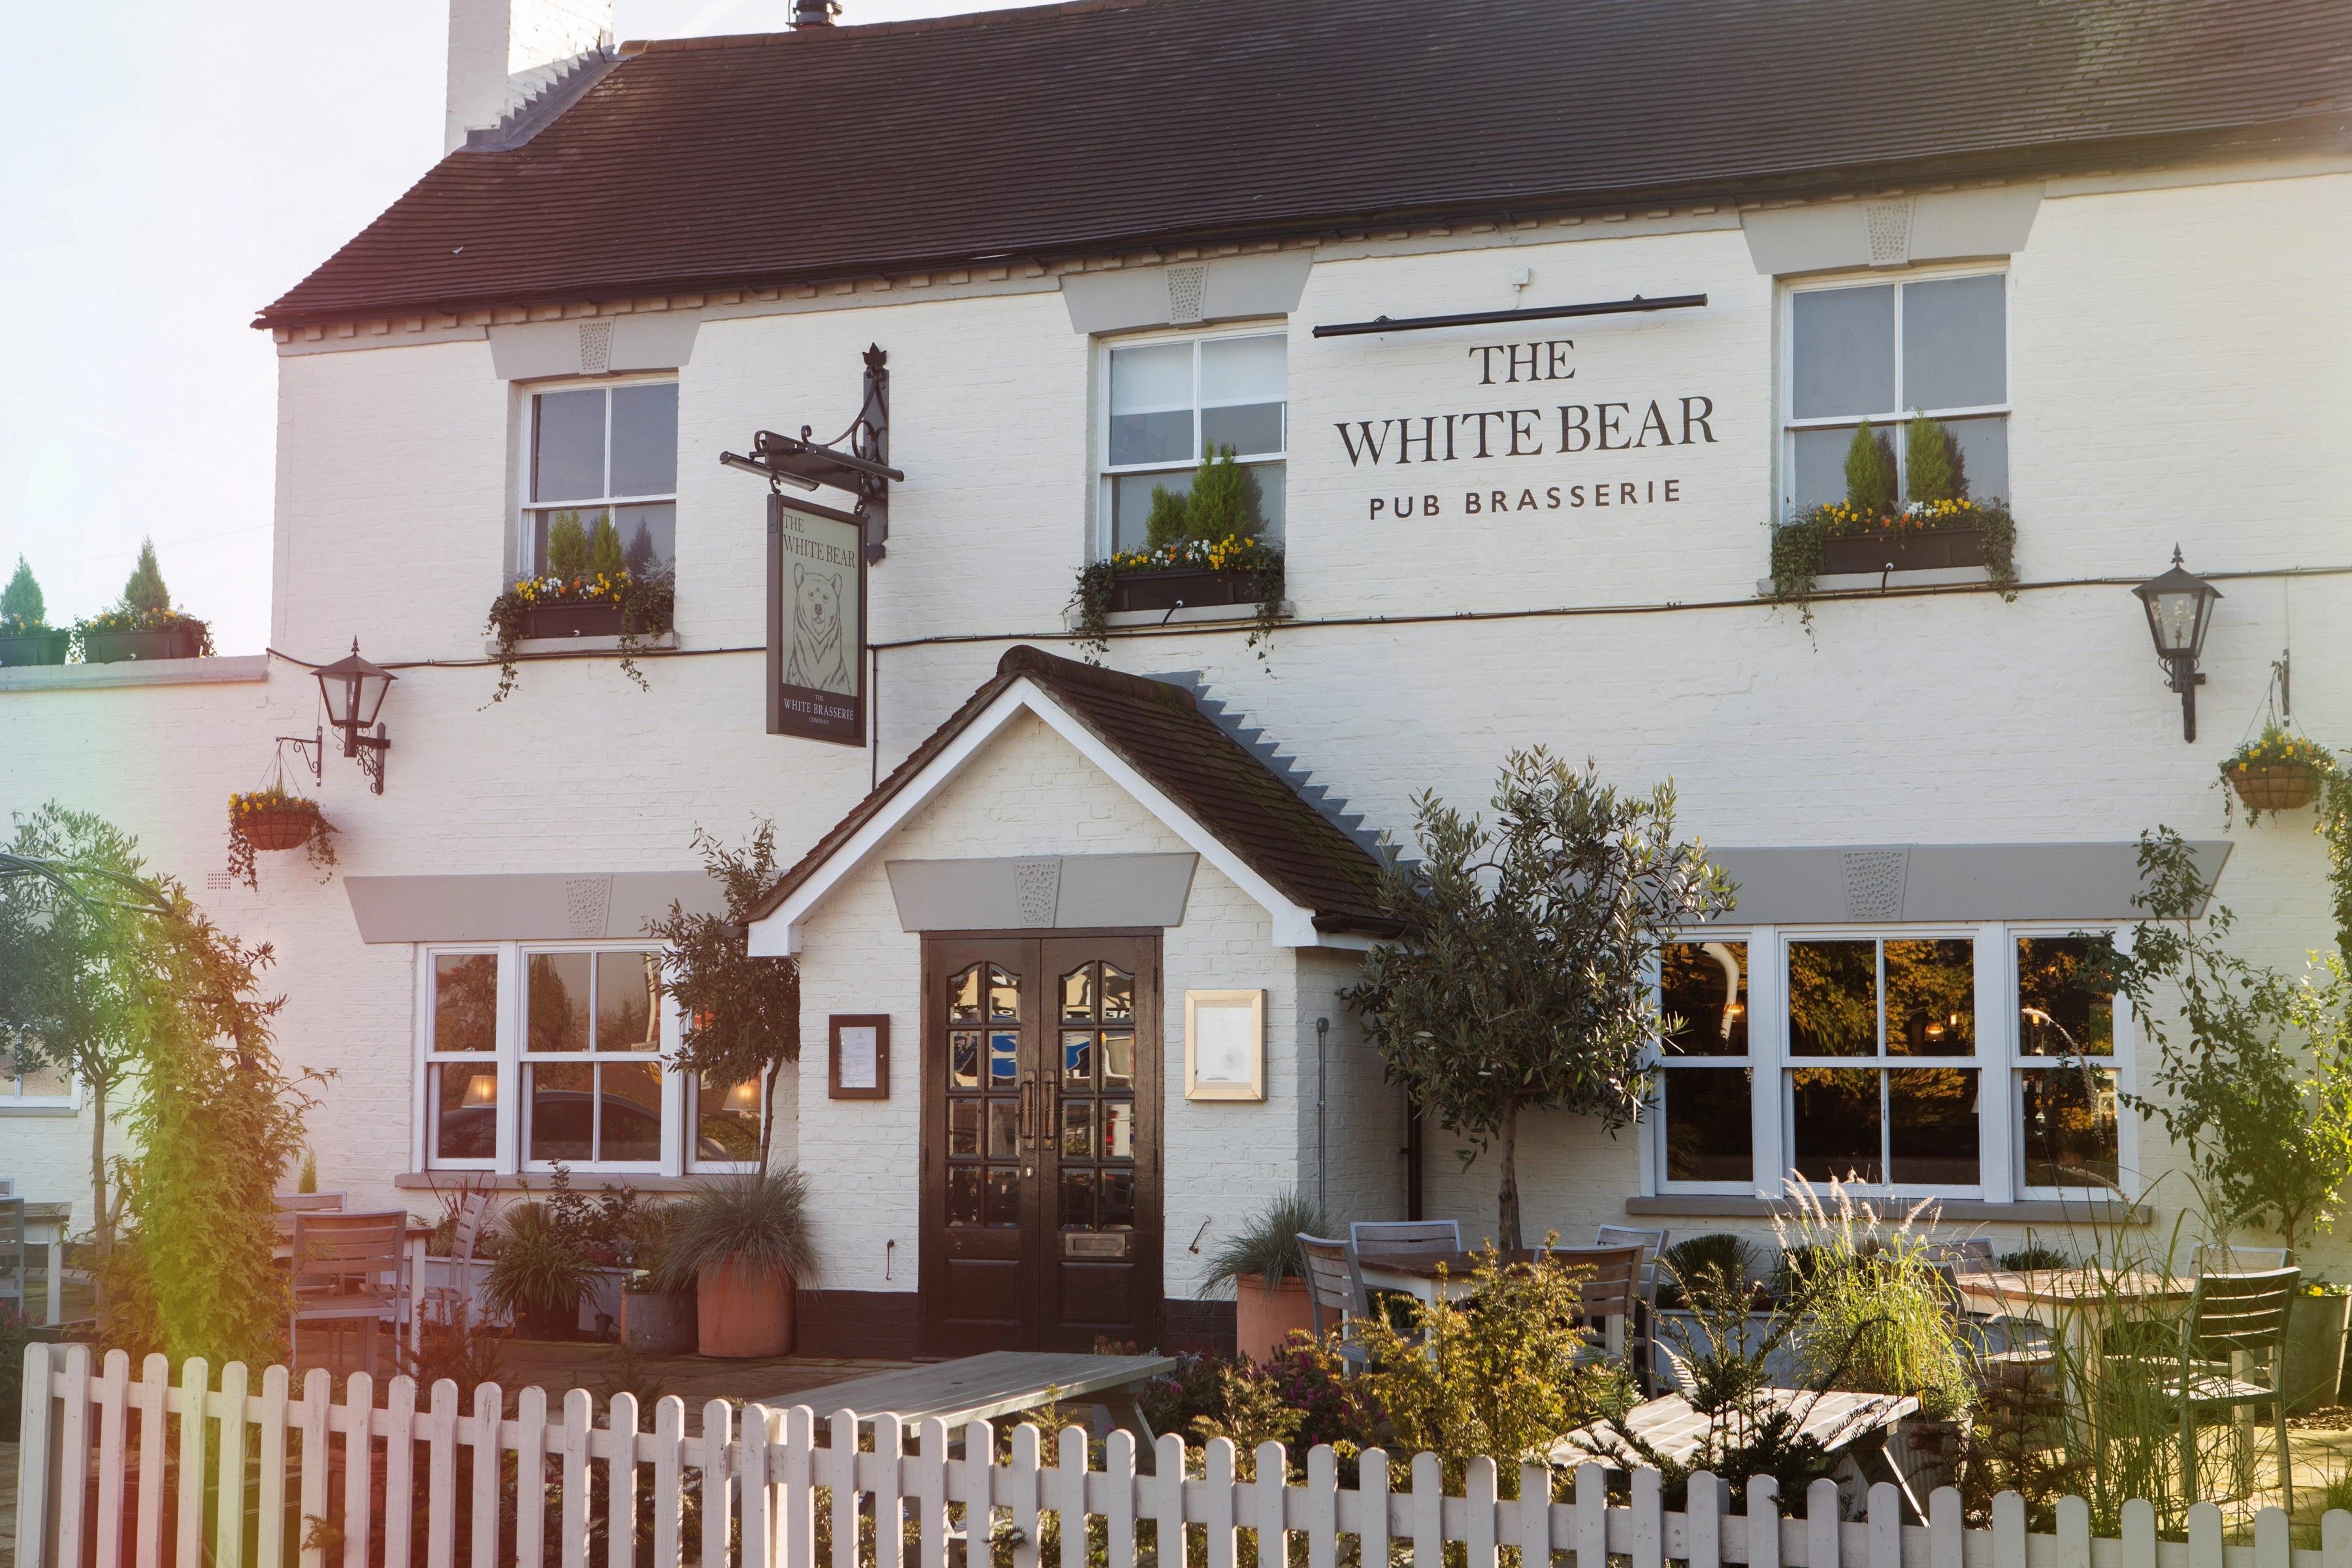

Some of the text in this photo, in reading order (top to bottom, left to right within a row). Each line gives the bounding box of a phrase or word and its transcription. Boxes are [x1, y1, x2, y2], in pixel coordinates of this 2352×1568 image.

[1469, 340, 1576, 385] THE
[1333, 396, 1719, 467] WHITE BEAR
[1370, 479, 1680, 520] PUB BRASSERIE
[783, 514, 804, 533] THE
[783, 534, 855, 568] WHITE BEAR
[784, 698, 854, 721] WHITE BRASSERIE
[809, 717, 830, 726] COMPANY
